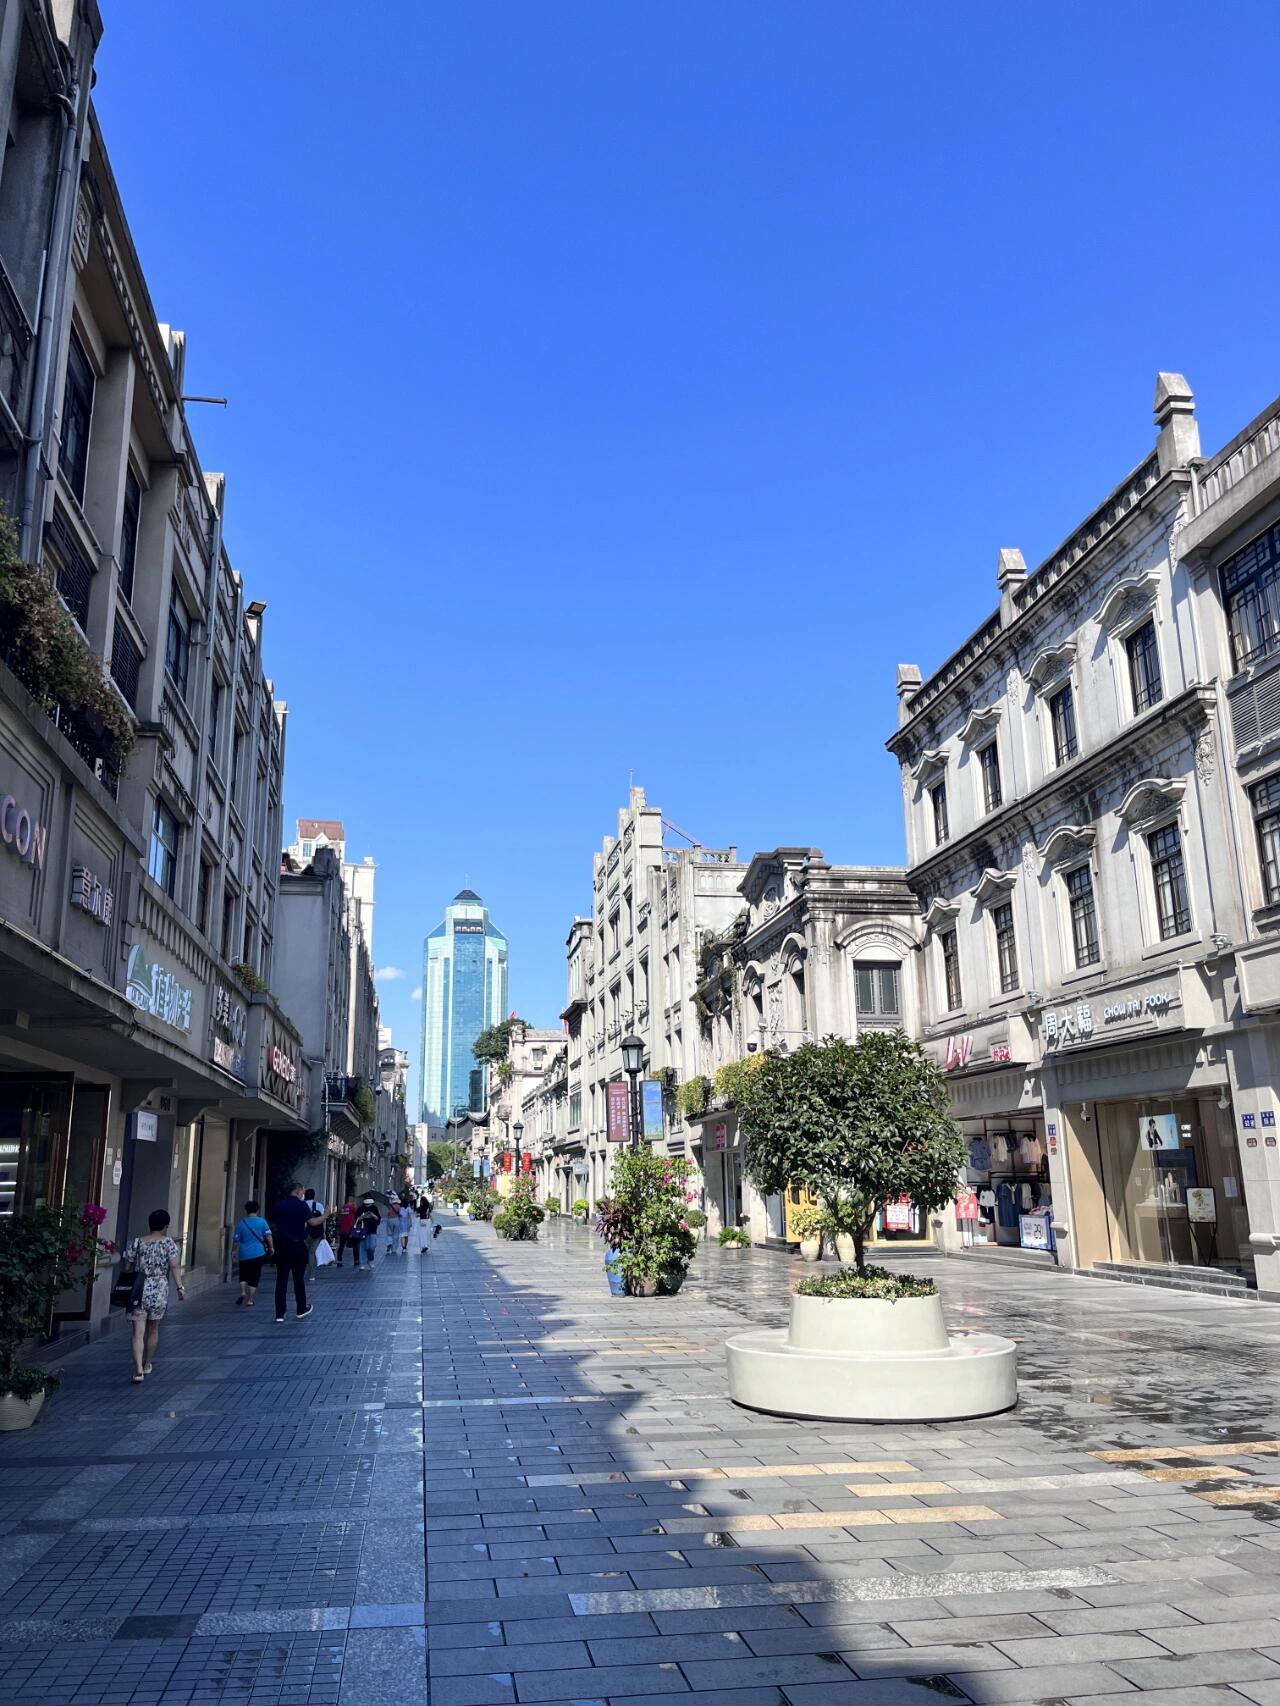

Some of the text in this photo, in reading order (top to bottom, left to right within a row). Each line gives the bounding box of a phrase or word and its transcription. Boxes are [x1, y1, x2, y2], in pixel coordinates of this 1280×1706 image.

[80, 866, 113, 927] 意尔康
[1044, 1004, 1092, 1041] 周大福
[1103, 992, 1170, 1019] CHOW TAI FOOK
